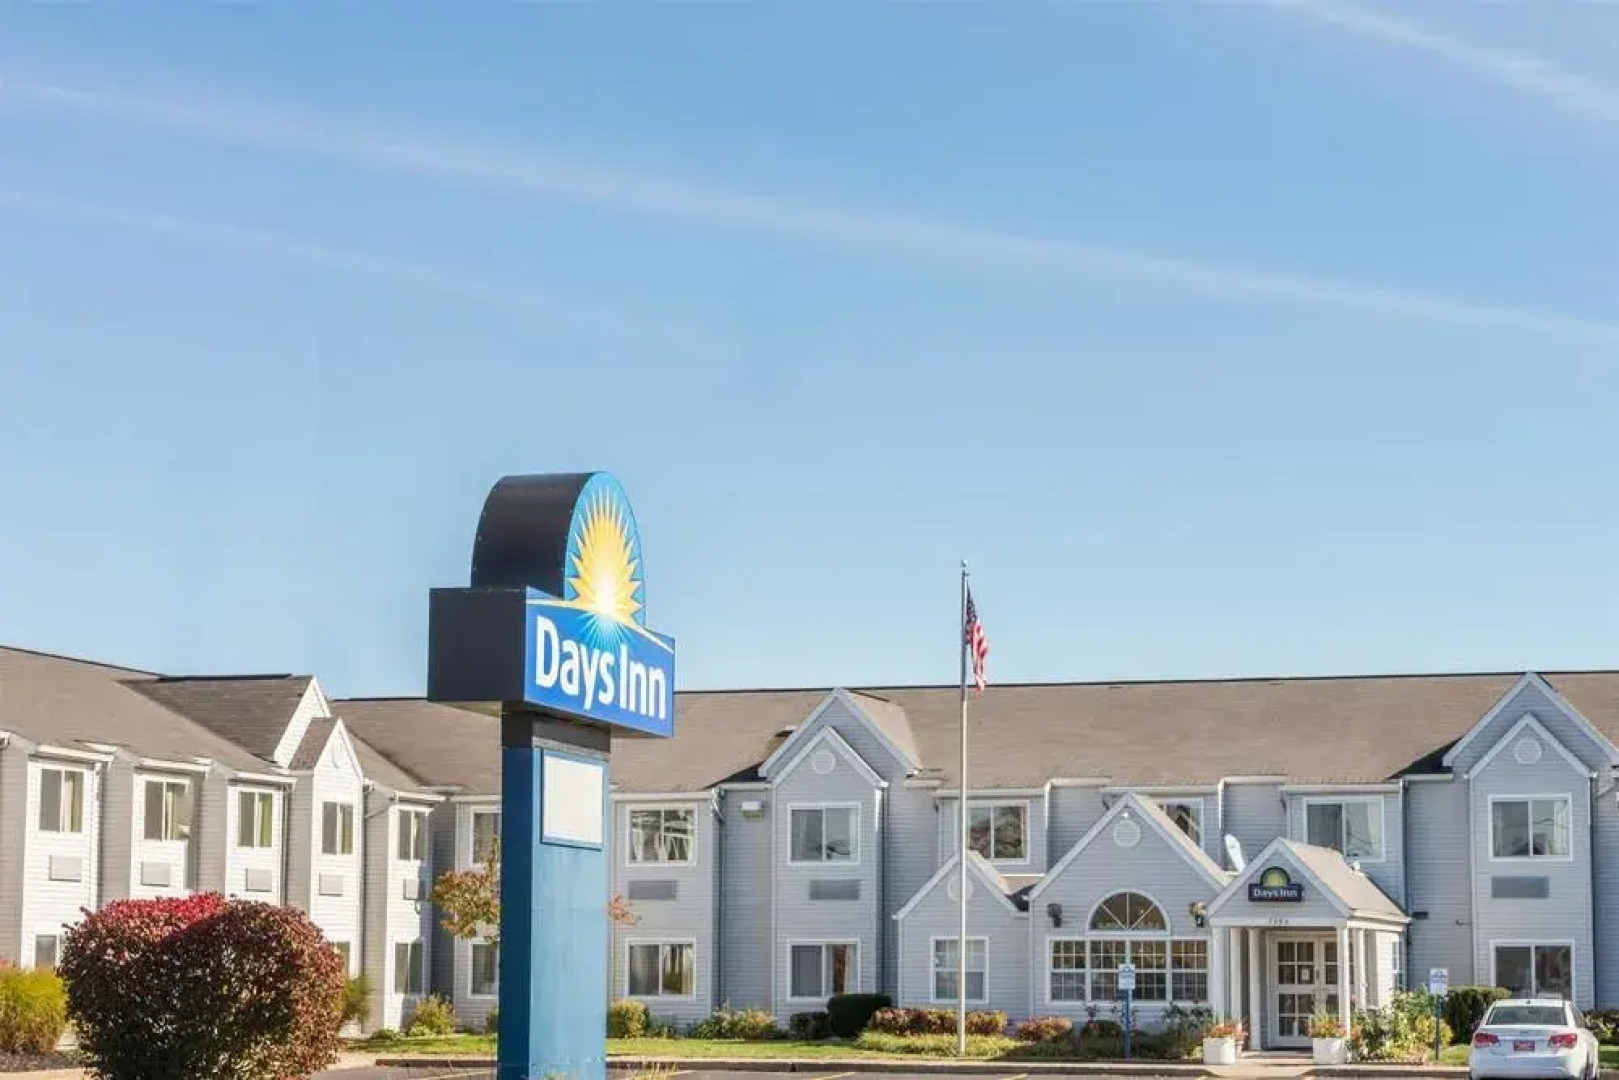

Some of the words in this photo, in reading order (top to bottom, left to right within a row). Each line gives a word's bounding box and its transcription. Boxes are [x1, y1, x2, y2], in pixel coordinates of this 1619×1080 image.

[535, 615, 615, 710] Days
[619, 644, 667, 720] Inn
[1253, 888, 1279, 898] Days
[1280, 888, 1298, 898] Inn
